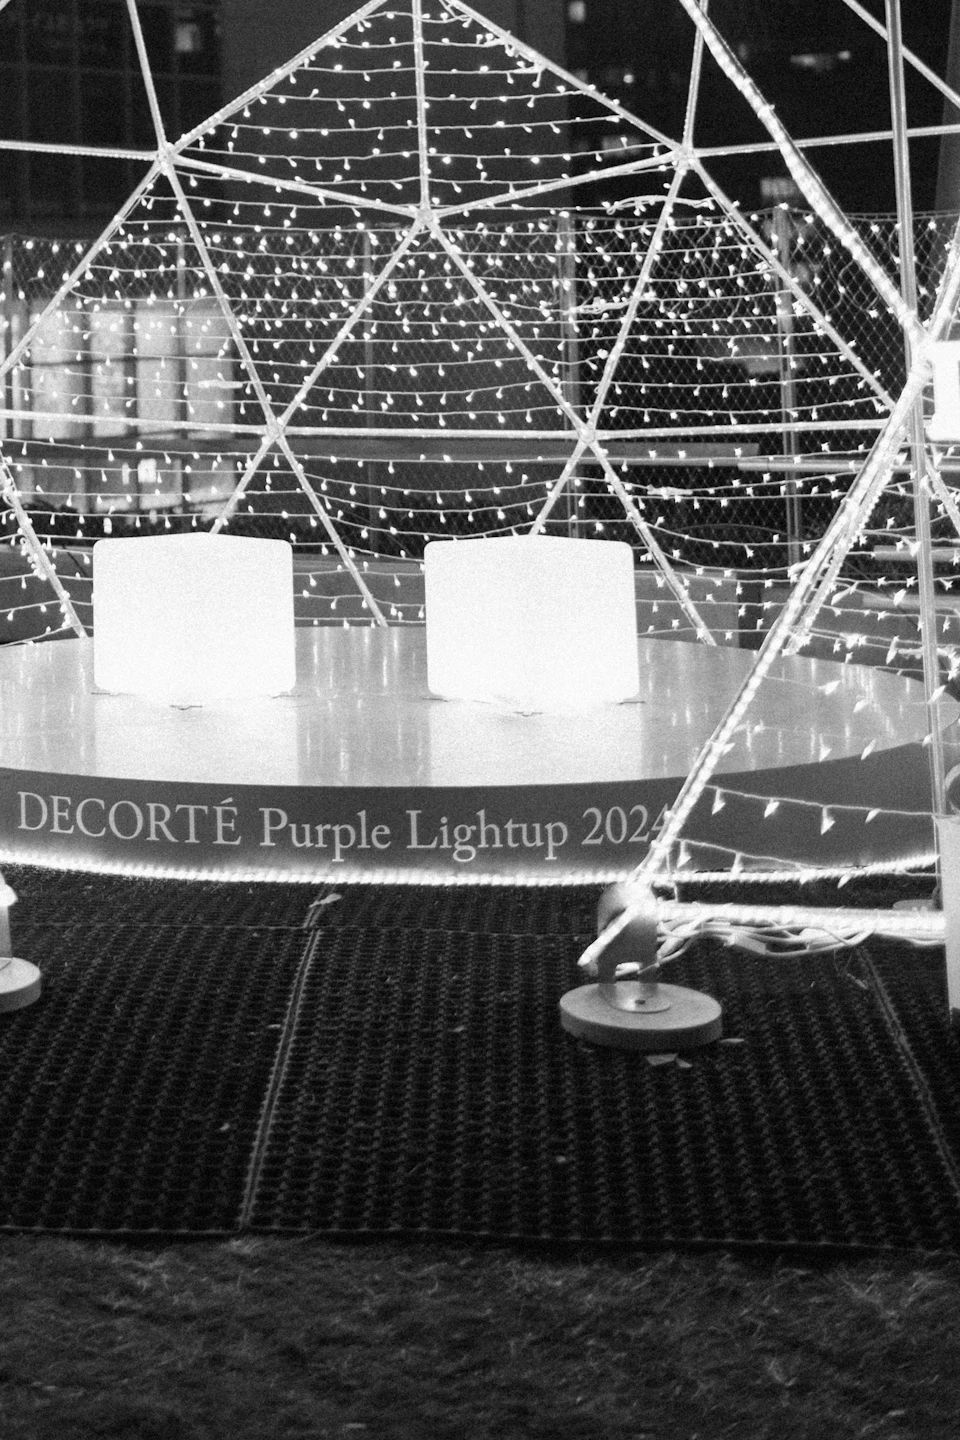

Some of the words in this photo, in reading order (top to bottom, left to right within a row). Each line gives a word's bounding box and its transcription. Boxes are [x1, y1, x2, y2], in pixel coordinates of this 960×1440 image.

[15, 789, 243, 846] DECORTÉ
[259, 806, 392, 863] Purple
[406, 807, 569, 863] Lightup
